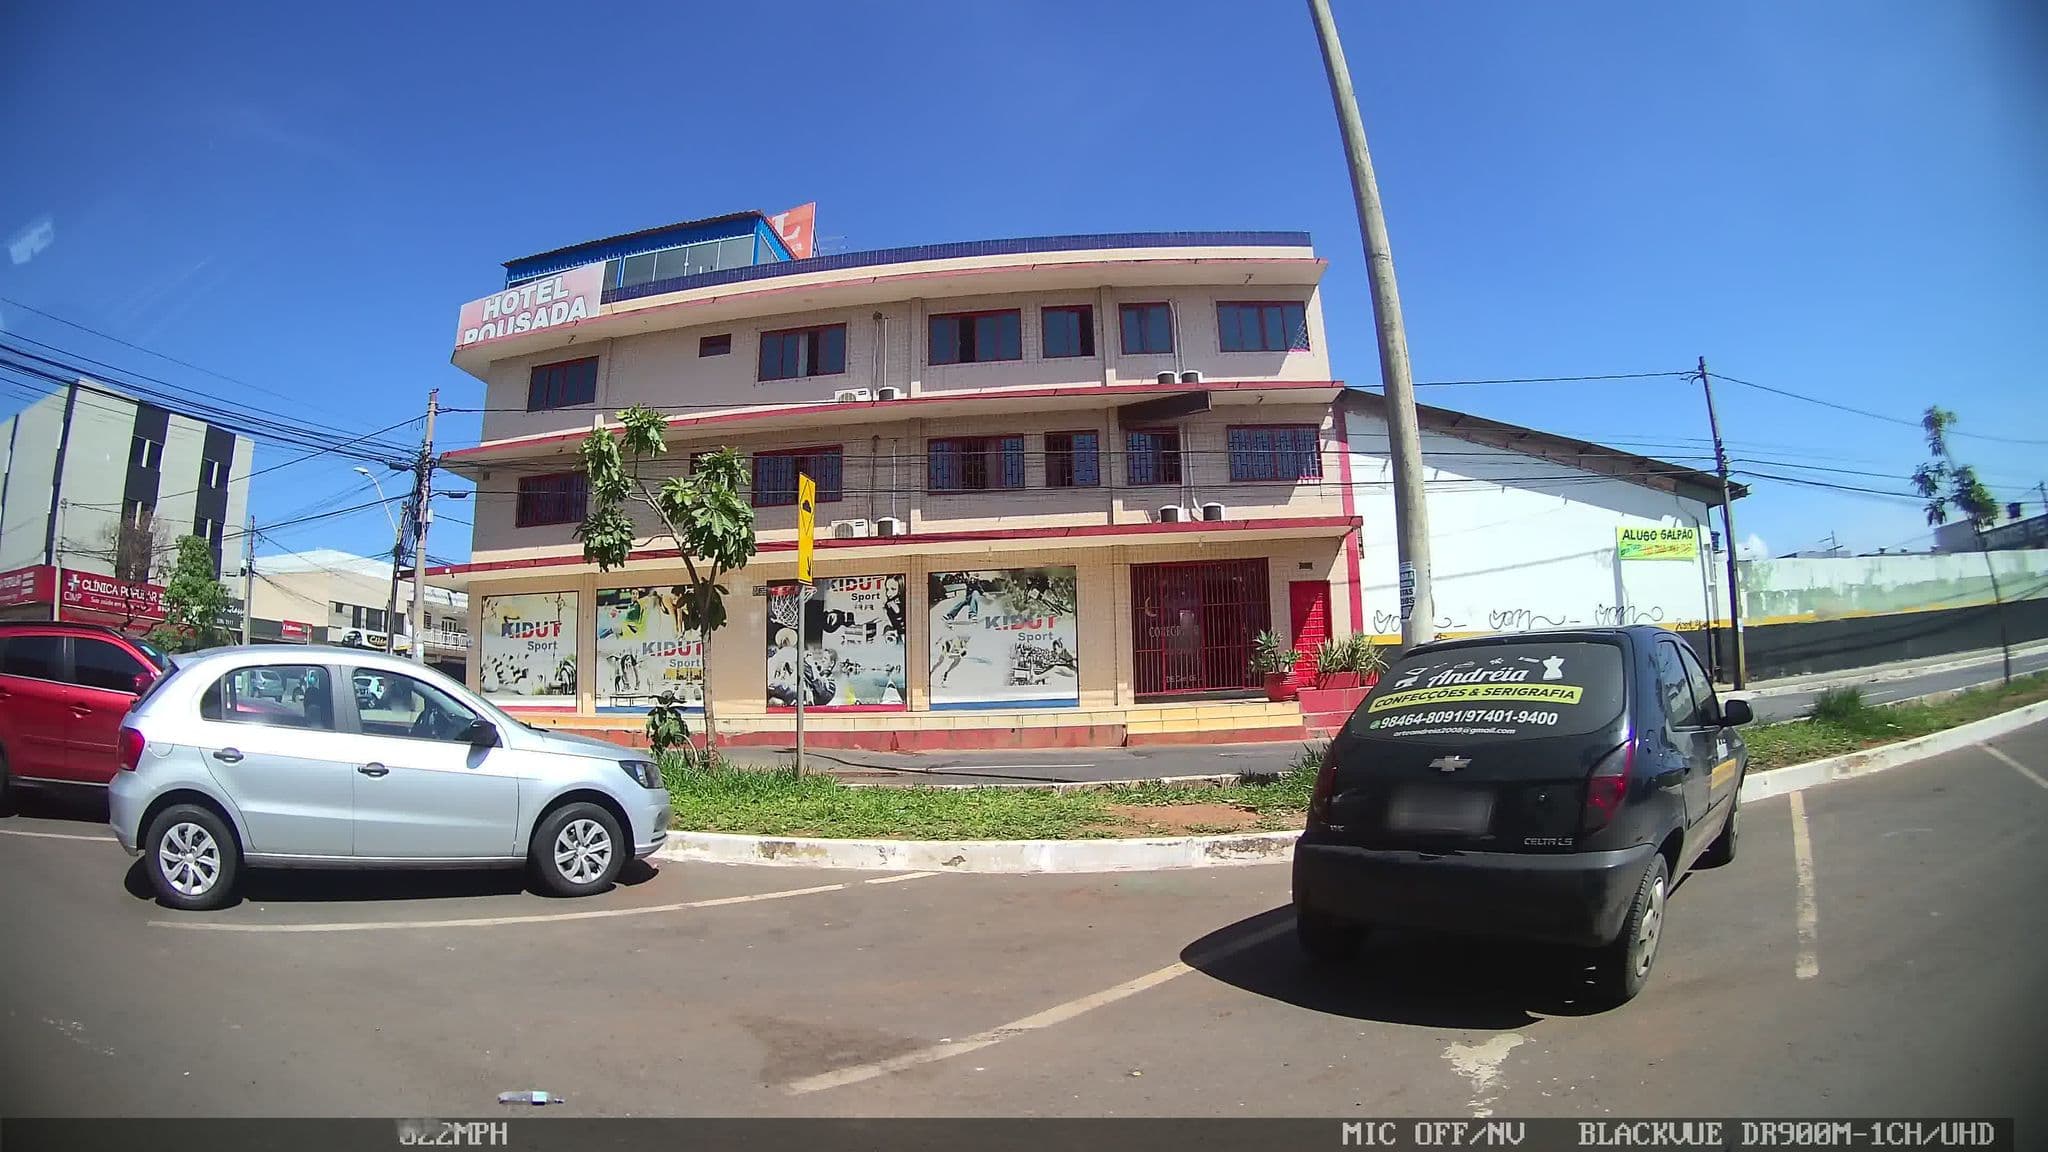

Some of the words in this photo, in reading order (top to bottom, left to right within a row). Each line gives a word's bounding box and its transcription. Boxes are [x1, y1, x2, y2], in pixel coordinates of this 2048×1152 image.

[482, 277, 569, 321] HOTEL
[463, 296, 588, 344] POUSADA
[81, 579, 119, 596] CLÍNICA
[829, 576, 885, 592] KIDUT
[851, 592, 881, 603] Sport
[501, 620, 562, 639] KIDUT
[984, 613, 1057, 631] KIDUT
[1018, 631, 1054, 642] Sport
[527, 640, 558, 653] Sport
[642, 640, 703, 657] KIDUT
[669, 658, 700, 669] Sport
[1427, 666, 1529, 688] Andréia
[1468, 688, 1480, 697] &
[1482, 687, 1575, 699] SERIGRAFIA
[1380, 709, 1558, 729] 98464-8091/97401-9400
